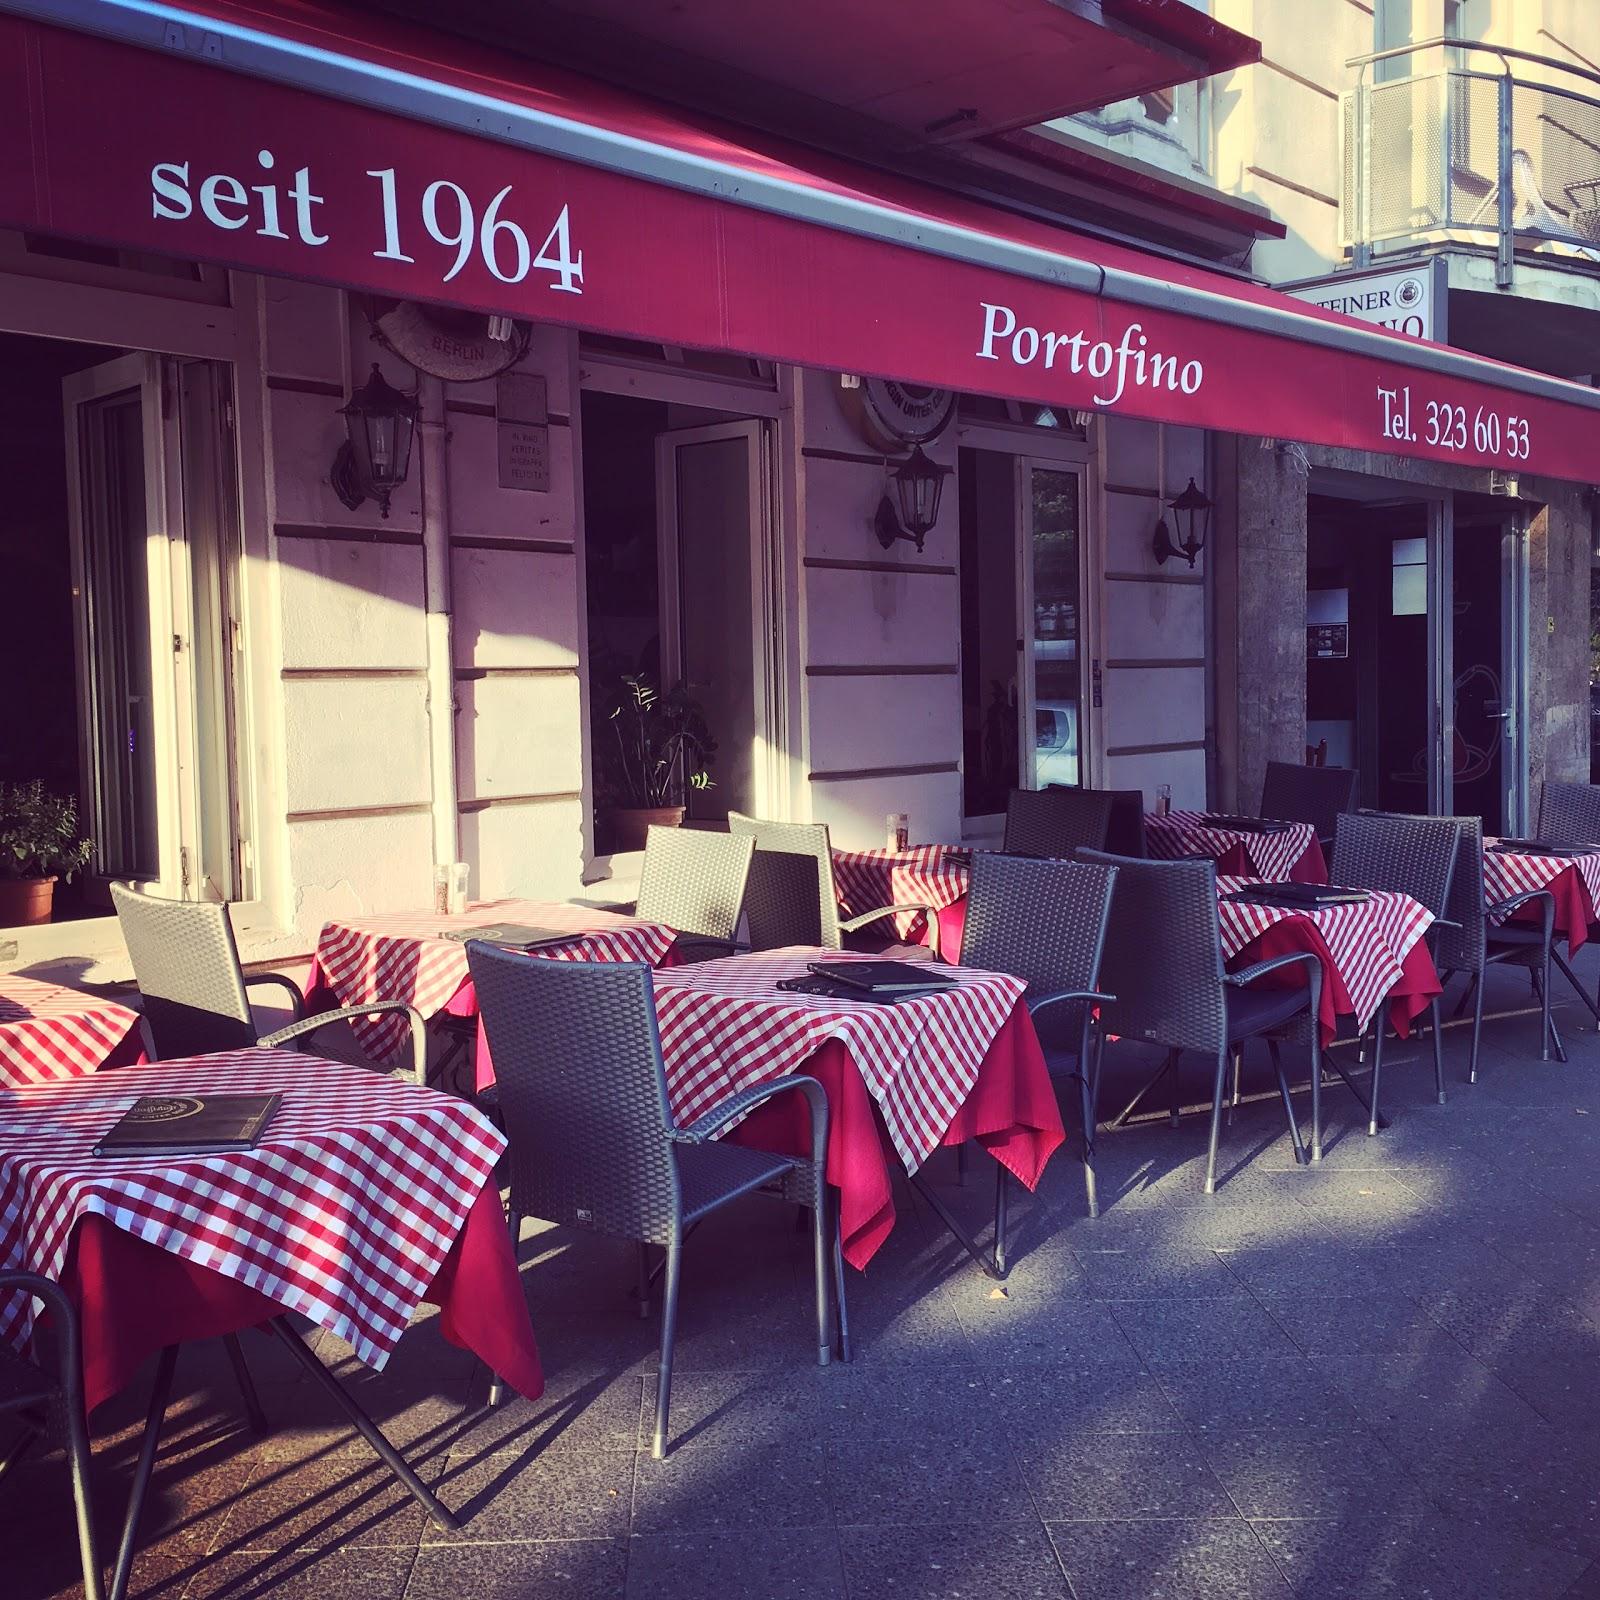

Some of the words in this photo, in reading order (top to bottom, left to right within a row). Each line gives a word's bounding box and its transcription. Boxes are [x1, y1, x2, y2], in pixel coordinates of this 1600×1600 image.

[151, 149, 329, 246] seit
[365, 167, 585, 295] 1964
[1314, 290, 1392, 314] TEINER
[432, 336, 486, 361] BERLIN
[975, 303, 1204, 406] Portofino
[1376, 385, 1418, 442] Tel.
[1425, 400, 1468, 452] 323
[1473, 405, 1501, 456] 60
[1506, 414, 1531, 461] 53
